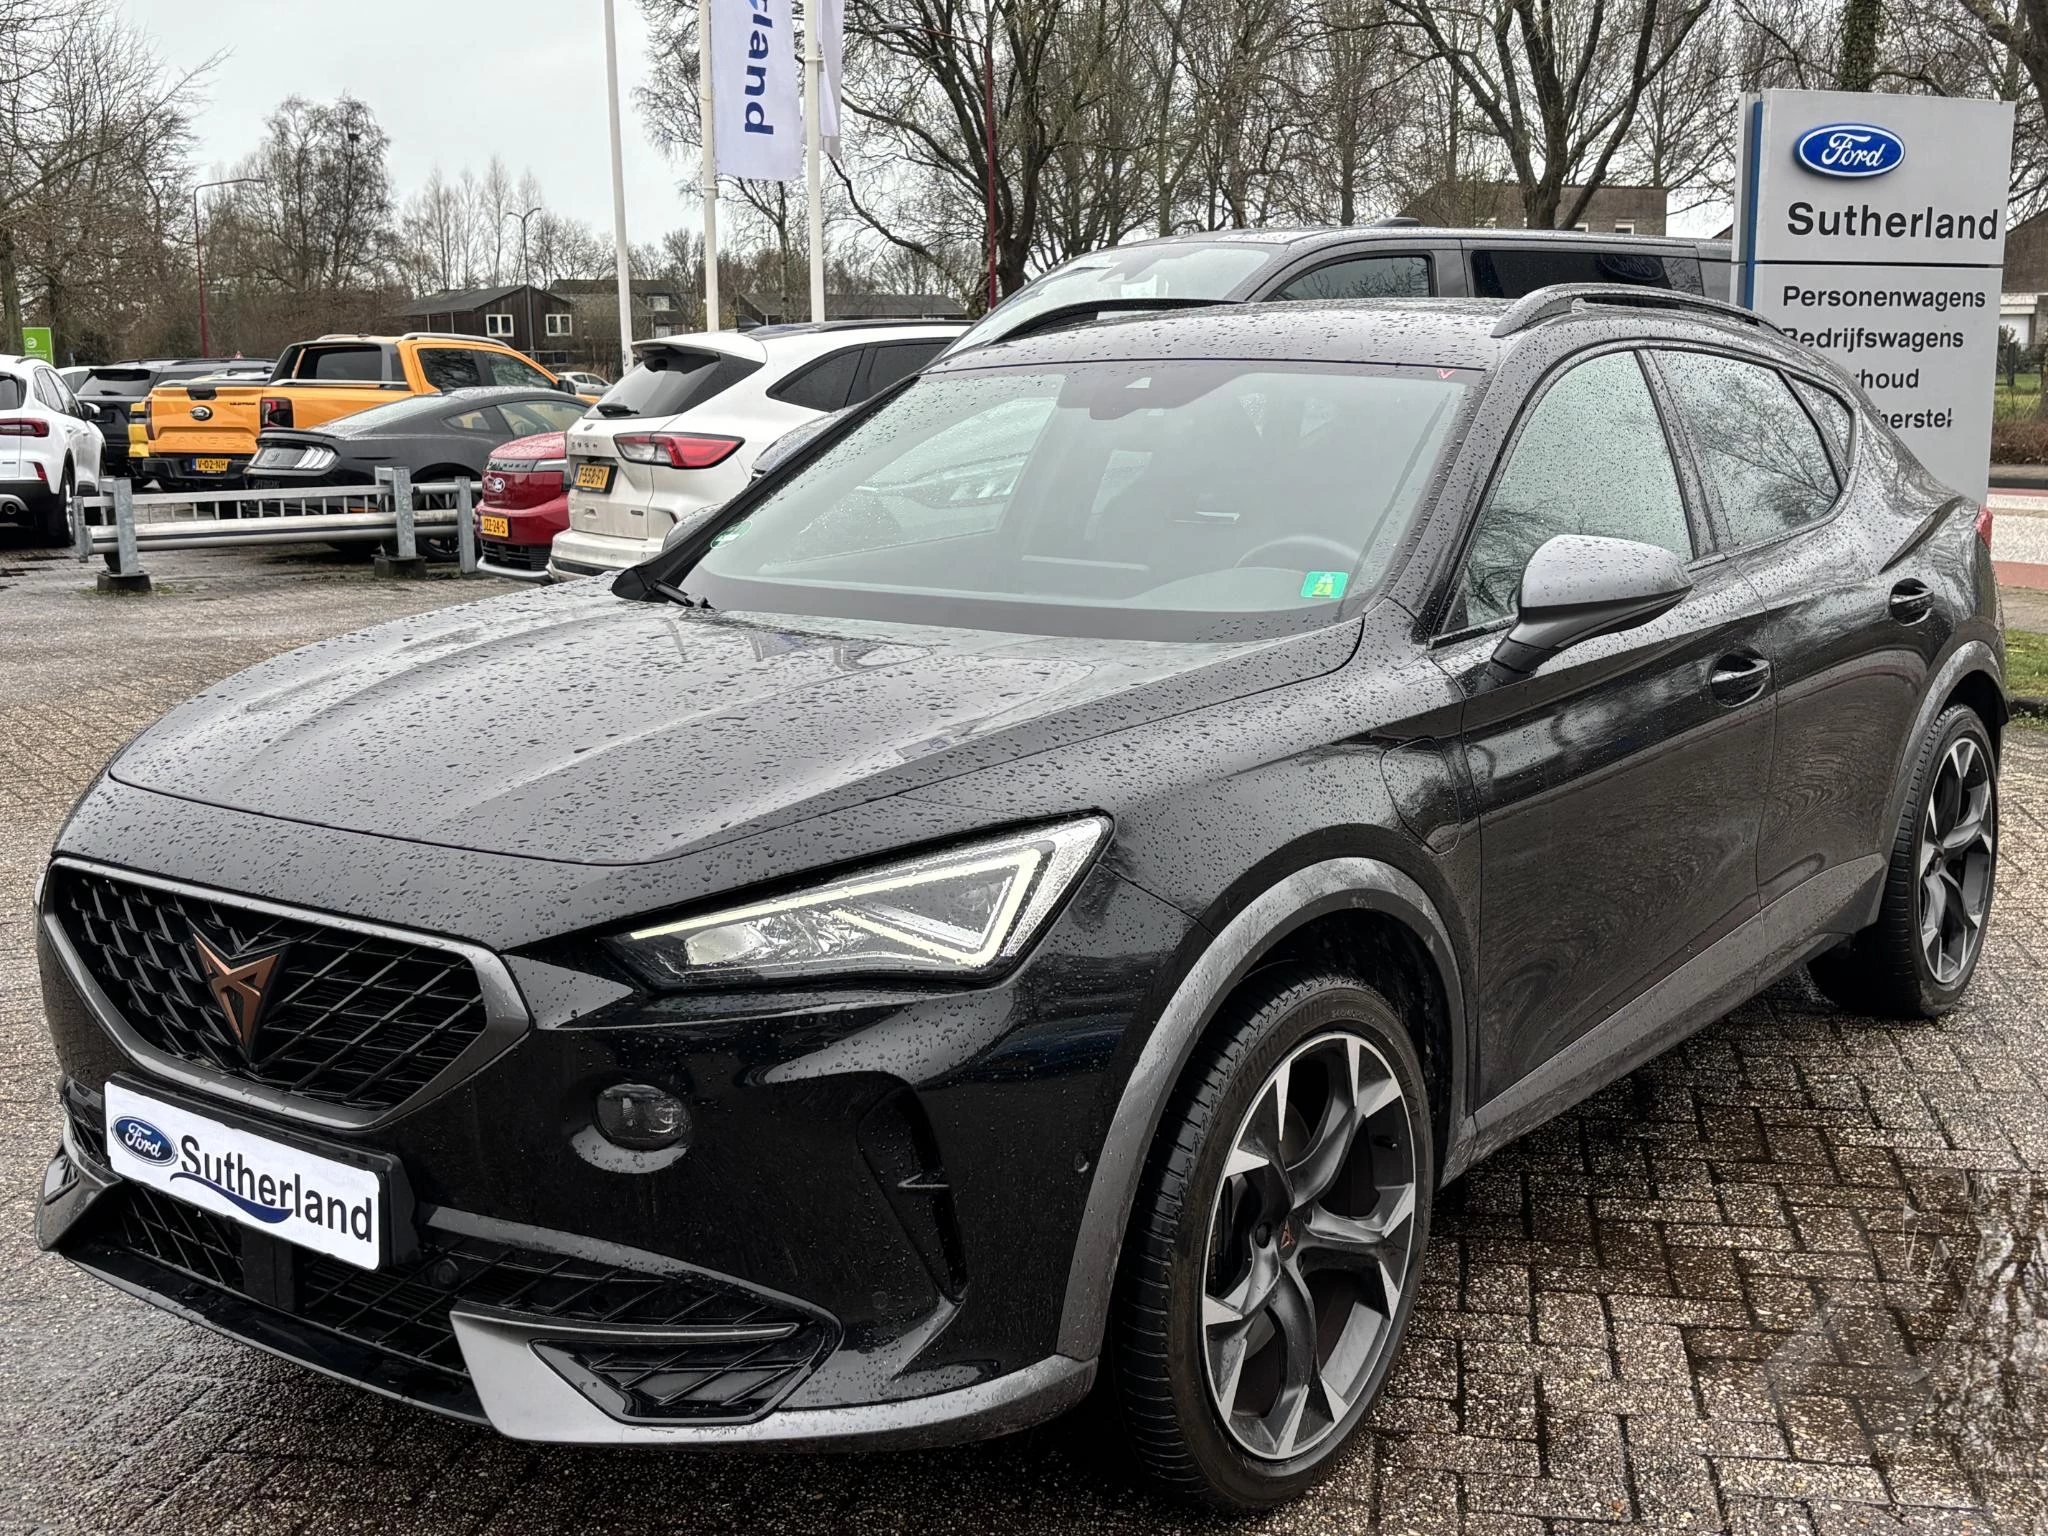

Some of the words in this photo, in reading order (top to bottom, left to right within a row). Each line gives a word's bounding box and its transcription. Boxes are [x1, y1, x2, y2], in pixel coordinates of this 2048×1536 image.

[1821, 132, 1887, 167] Ford
[1787, 202, 1999, 241] Sutherland
[1782, 285, 1987, 312] Personenwagens
[1854, 368, 1920, 389] houd
[123, 1121, 162, 1159] Ford
[180, 1134, 373, 1244] Sutherland
